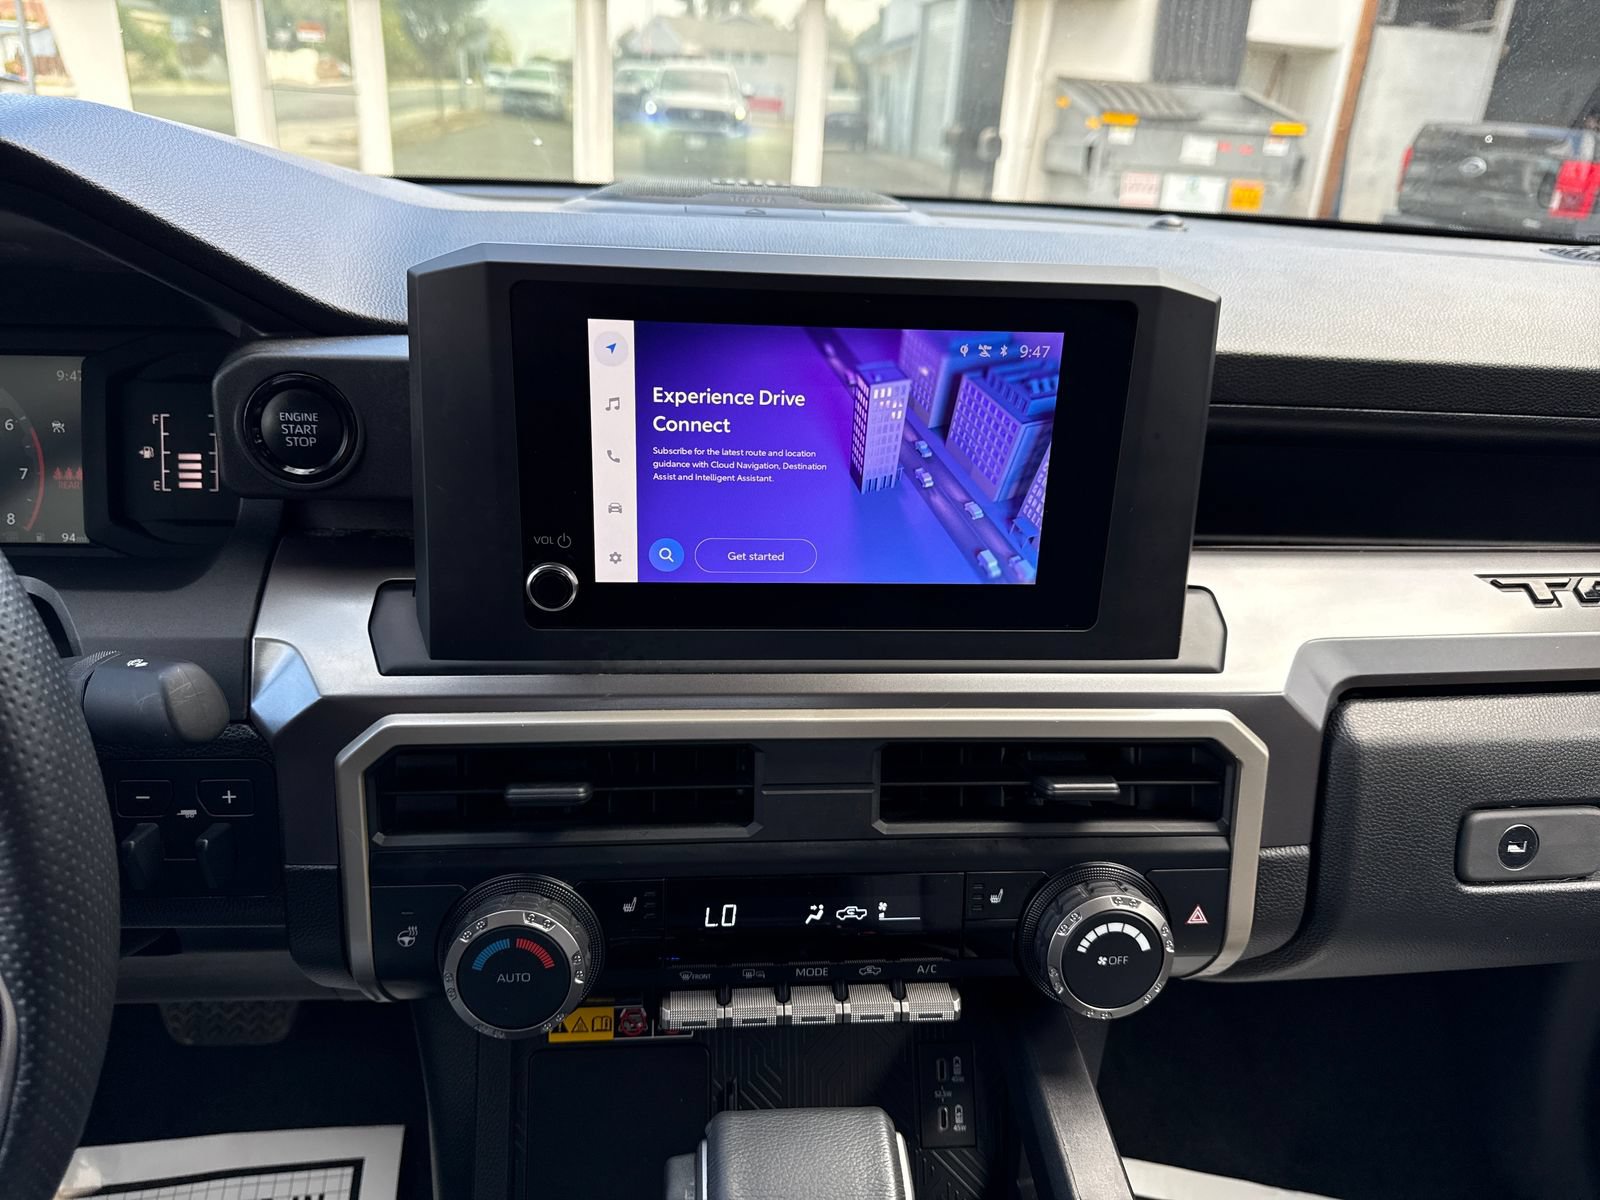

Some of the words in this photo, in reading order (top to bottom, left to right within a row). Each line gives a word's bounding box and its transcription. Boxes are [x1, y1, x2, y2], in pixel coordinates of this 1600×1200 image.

[1019, 344, 1051, 359] 9:47
[652, 386, 755, 407] Experience
[759, 389, 806, 407] Drive
[152, 414, 159, 425] F
[279, 412, 319, 422] ENGINE
[4, 418, 15, 431] 6
[281, 424, 318, 435] START
[652, 415, 731, 433] Connect
[285, 436, 317, 447] STOP
[652, 447, 693, 455] Subscribe
[693, 447, 706, 455] for
[706, 448, 720, 456] the
[721, 448, 745, 456] latest
[745, 449, 767, 457] route
[767, 449, 784, 457] and
[785, 449, 816, 457] location
[652, 460, 691, 469] guidance
[691, 460, 709, 468] with
[710, 460, 735, 469] Cloud
[736, 461, 781, 471] Navigation,
[782, 462, 827, 471] Destination
[18, 468, 28, 480] 7
[652, 473, 677, 481] Assist
[677, 473, 694, 481] and
[695, 473, 735, 483] Intelligent
[736, 474, 774, 482] Assistant.
[153, 480, 160, 491] E
[6, 512, 16, 525] 8
[61, 532, 76, 543] 94
[533, 535, 554, 545] VOL
[727, 551, 747, 561] Get
[748, 551, 785, 561] started
[704, 903, 737, 928] LO
[1108, 955, 1129, 965] OFF
[795, 967, 829, 977] MODE
[916, 964, 937, 974] A/C
[496, 972, 531, 983] AUTO
